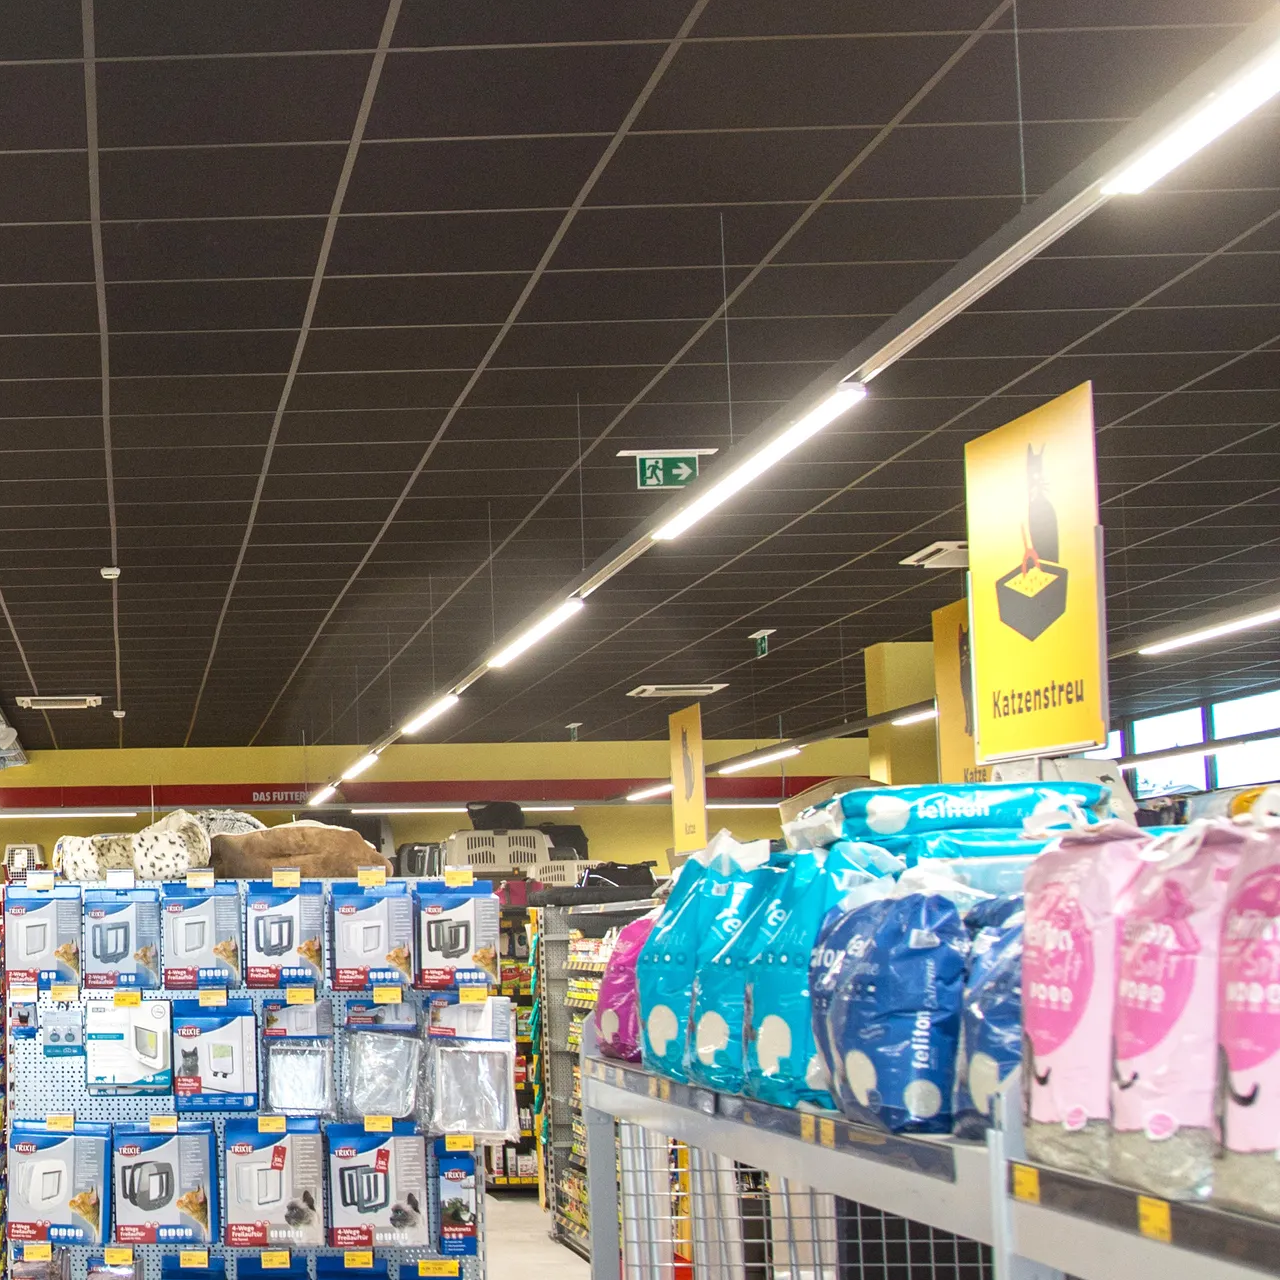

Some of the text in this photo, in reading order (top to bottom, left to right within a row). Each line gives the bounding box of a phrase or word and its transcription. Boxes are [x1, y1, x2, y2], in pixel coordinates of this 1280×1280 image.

[992, 678, 1085, 719] Katzenstreu
[963, 767, 987, 783] Katze
[252, 792, 271, 802] DAS
[8, 907, 27, 915] TRIXIE
[166, 904, 184, 912] TRIXIE
[338, 906, 357, 914] TRIXIE
[424, 906, 443, 914] TRIXIE
[87, 910, 106, 918] TRIXIE
[177, 1026, 201, 1037] TRIXIE
[911, 1010, 931, 1069] feliton
[14, 1144, 37, 1153] TRIXIE
[118, 1147, 141, 1155] TRIXIE
[230, 1145, 253, 1154] TRIXIE
[334, 1149, 357, 1157] TRIXIE
[444, 1171, 467, 1179] TRIXIE
[231, 1225, 255, 1233] 4-Wege
[337, 1228, 360, 1236] 4-Wege
